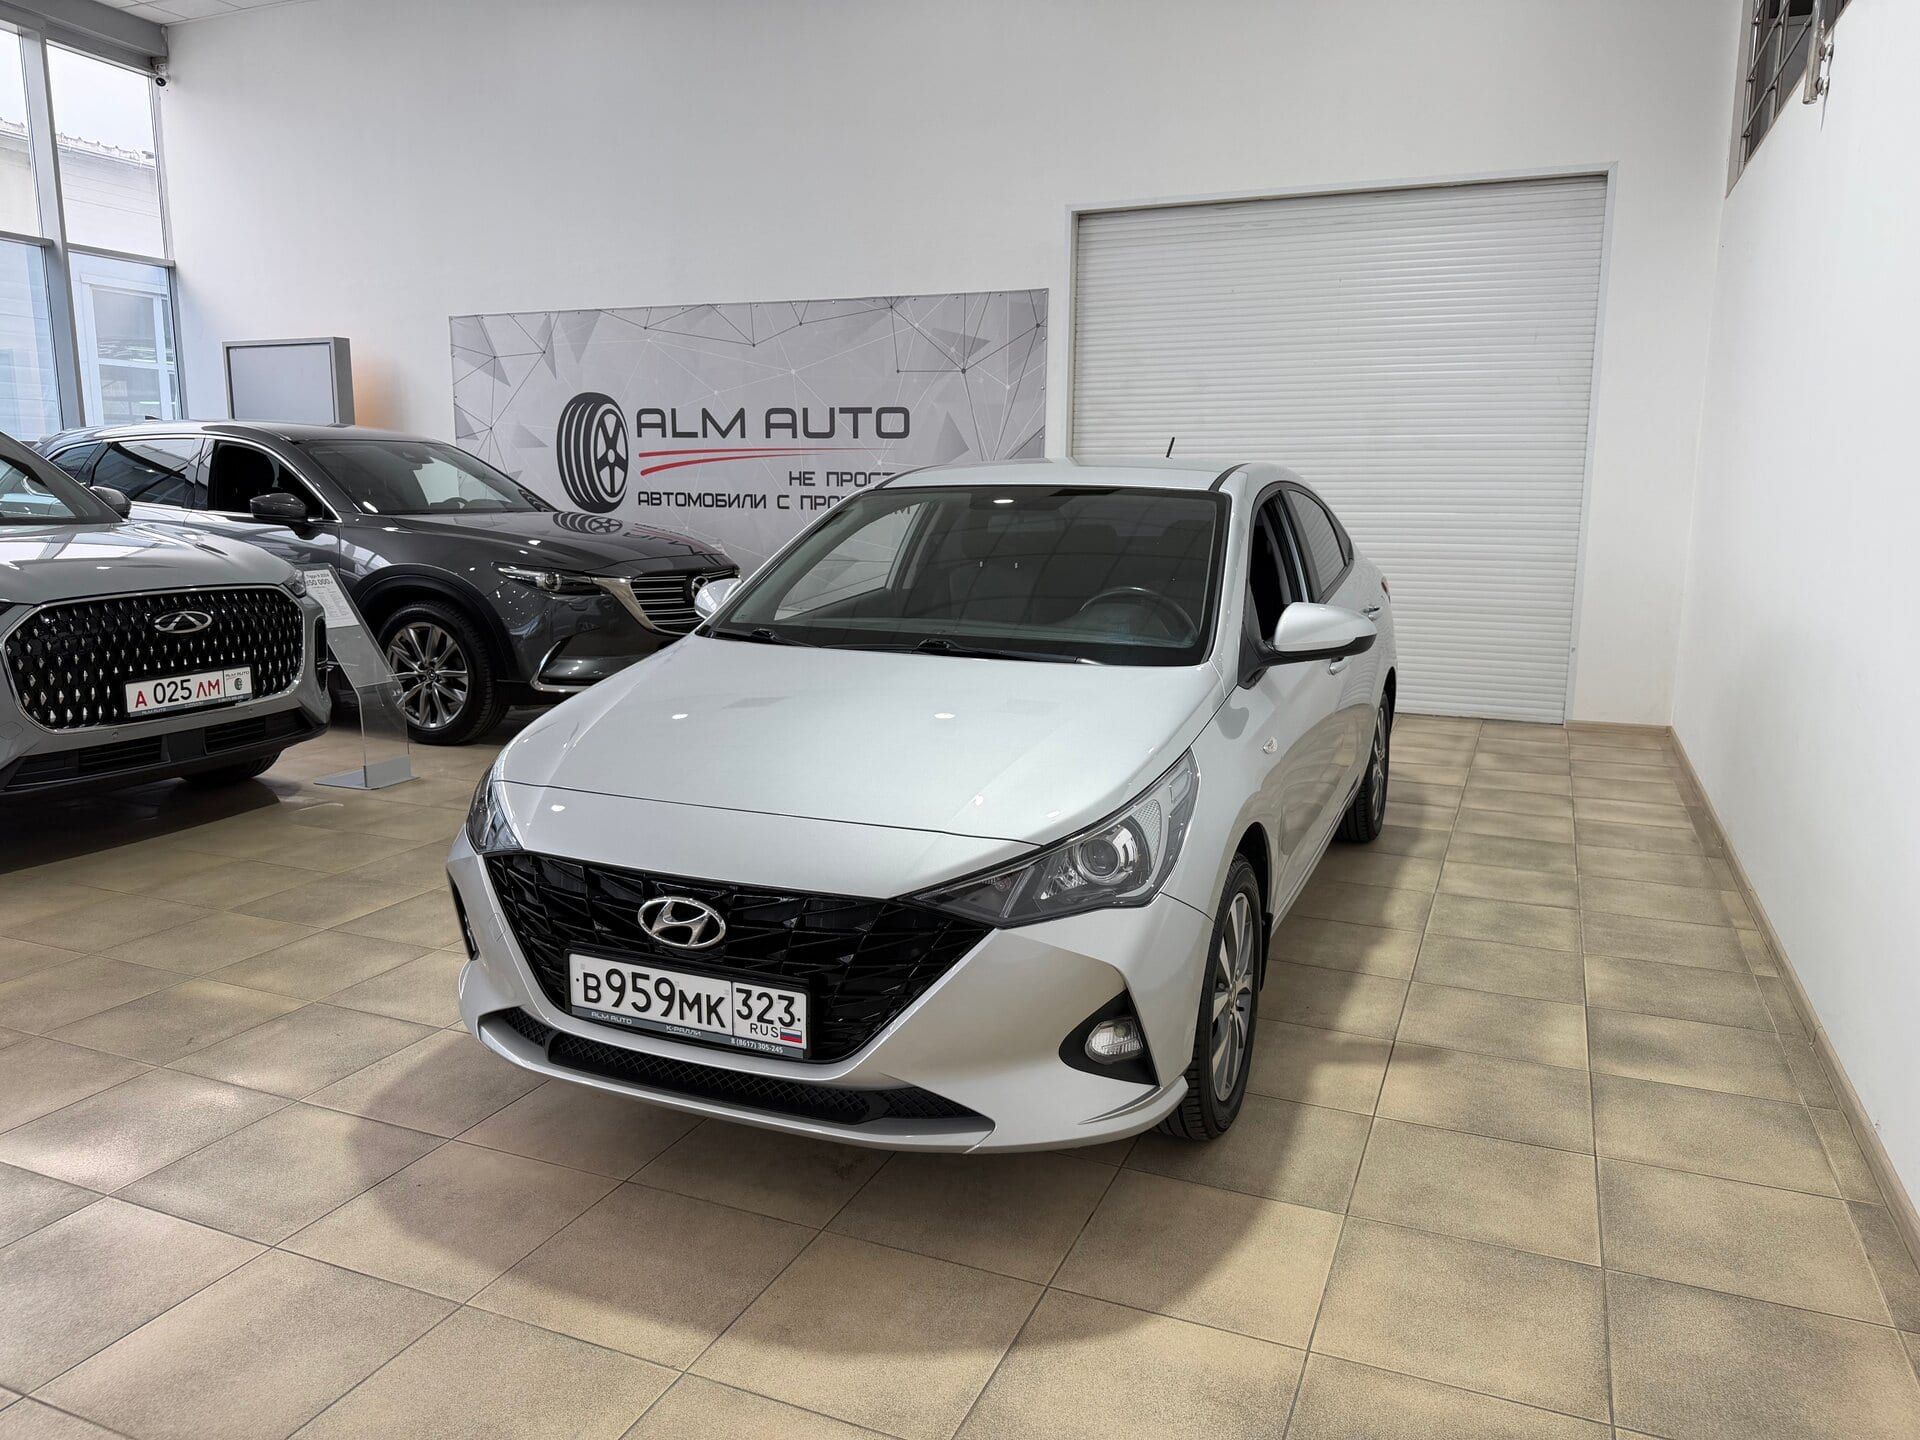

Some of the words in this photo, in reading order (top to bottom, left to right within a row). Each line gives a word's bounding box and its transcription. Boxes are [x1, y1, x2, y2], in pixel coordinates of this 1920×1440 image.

[636, 407, 746, 439] ALM
[765, 406, 910, 439] AUTO
[789, 471, 816, 486] НЕ
[638, 491, 767, 510] АВТОМОБИЛИ
[777, 495, 790, 510] С
[153, 679, 193, 705] 025
[736, 987, 796, 1027] 323
[591, 1011, 610, 1021] ALM
[610, 1015, 633, 1025] AUTO
[750, 1022, 779, 1038] RUS
[758, 1042, 784, 1054] 305-245
